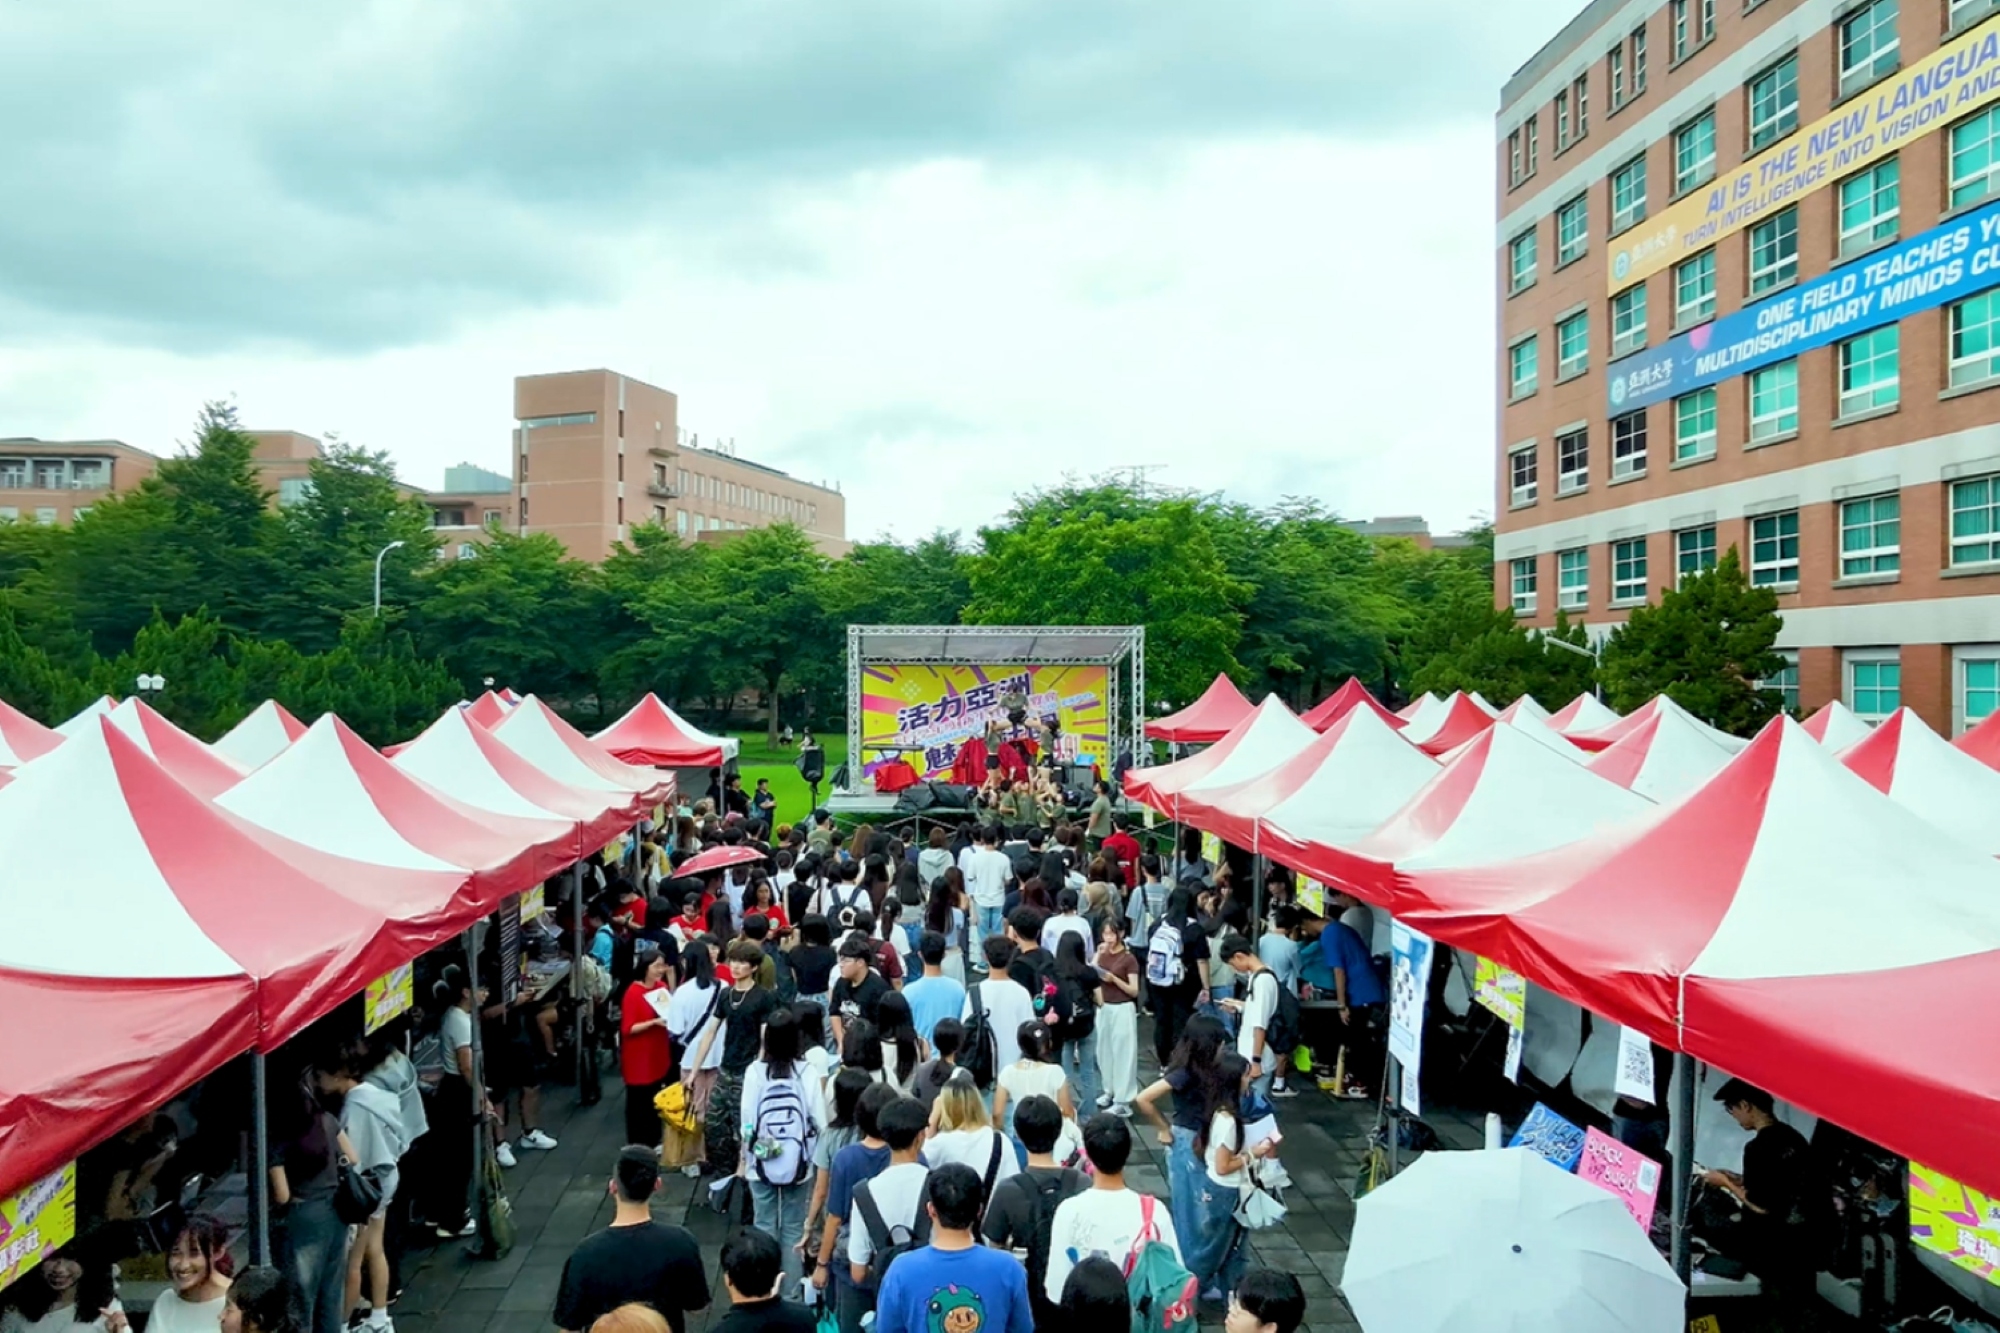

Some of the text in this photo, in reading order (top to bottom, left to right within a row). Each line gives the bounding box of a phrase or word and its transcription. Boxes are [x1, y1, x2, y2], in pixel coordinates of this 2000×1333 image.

[1682, 218, 1718, 250] TURN
[1721, 164, 1826, 230] INTELLIGENCE
[1832, 134, 1874, 171] INTO
[1881, 92, 1948, 145] VISION
[1705, 192, 1725, 218] AI
[1732, 175, 1753, 203] IS
[1760, 145, 1799, 184] THE
[1806, 104, 1869, 158] NEW
[1694, 291, 1874, 377] MULTIDISCIPLINARY
[1879, 256, 1963, 310] MINDS
[1756, 303, 1796, 332] ONE
[1800, 273, 1856, 314] FIELD
[1863, 225, 1971, 290] TEACHES
